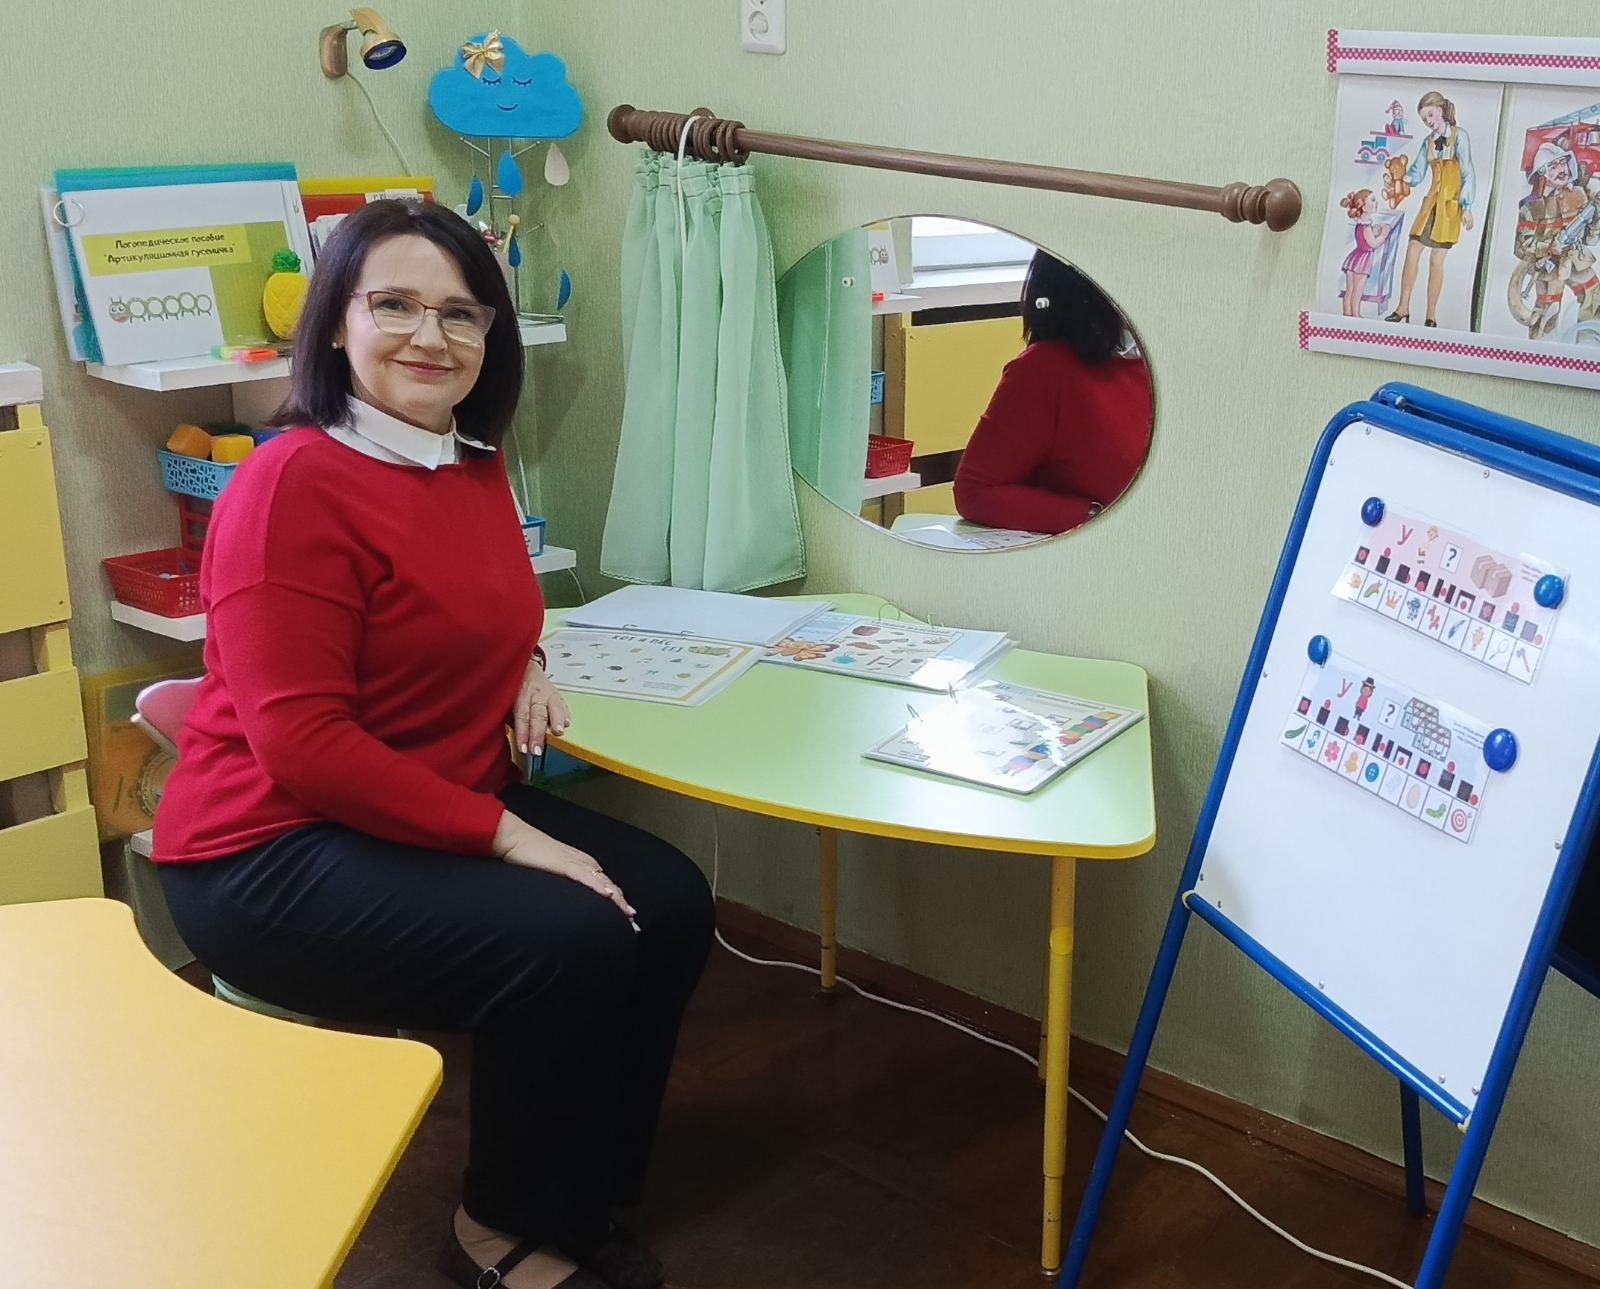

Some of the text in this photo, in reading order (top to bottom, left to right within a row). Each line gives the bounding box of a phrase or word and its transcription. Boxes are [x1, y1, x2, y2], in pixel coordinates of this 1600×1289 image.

[115, 233, 225, 249] Логопедическое пособие
[1445, 547, 1458, 568] ?
[1384, 703, 1397, 723] ?
